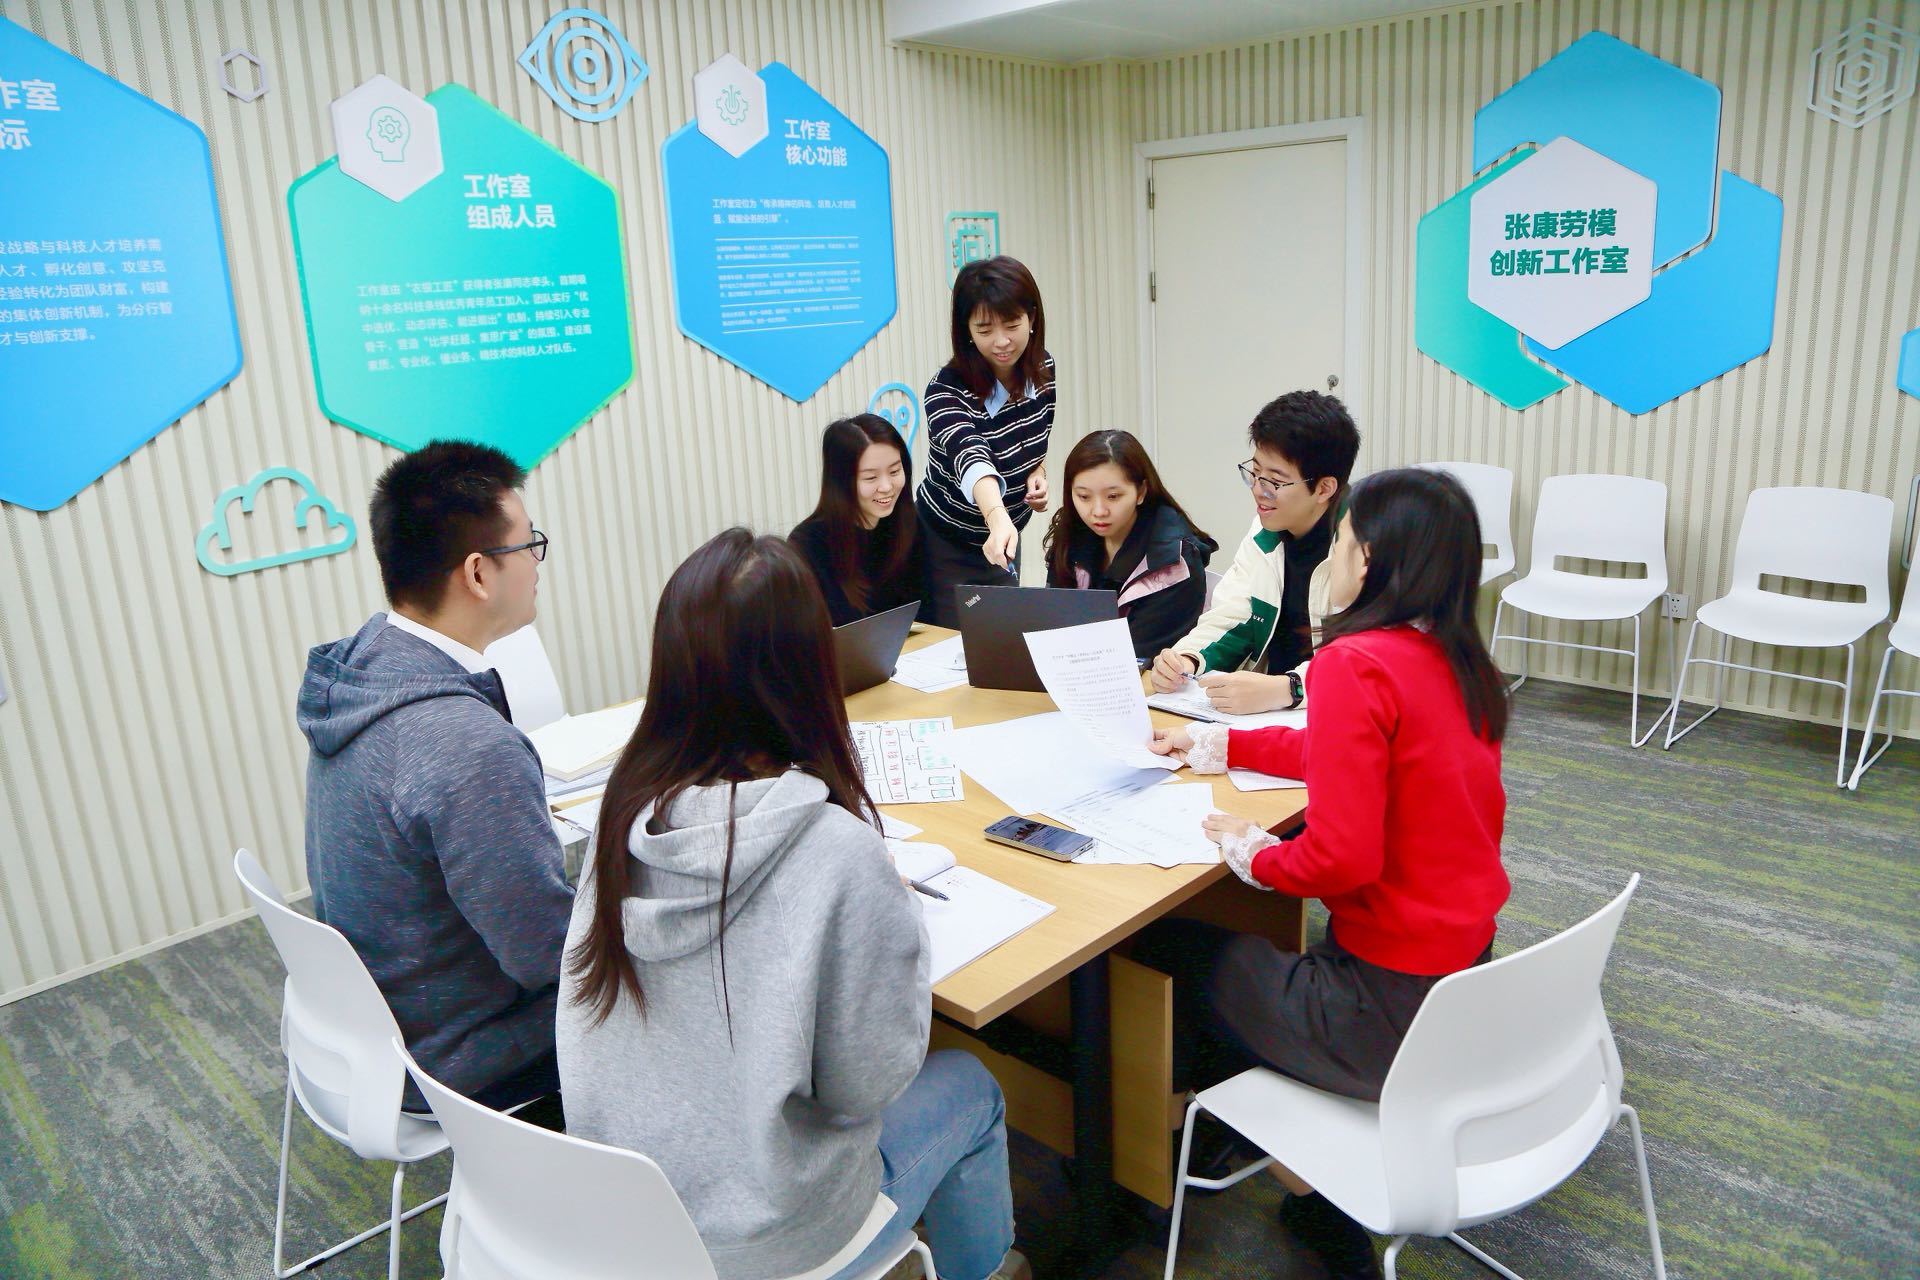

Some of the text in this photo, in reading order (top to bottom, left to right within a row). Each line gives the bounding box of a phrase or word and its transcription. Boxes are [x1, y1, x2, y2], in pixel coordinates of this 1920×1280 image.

[0, 119, 32, 150] 标
[784, 119, 831, 140] 工作室
[785, 144, 848, 167] 核心功能
[463, 173, 532, 199] 工作室
[466, 203, 557, 229] 组成人员
[1504, 208, 1617, 240] 张康劳模
[1490, 246, 1629, 276] 创新工作室
